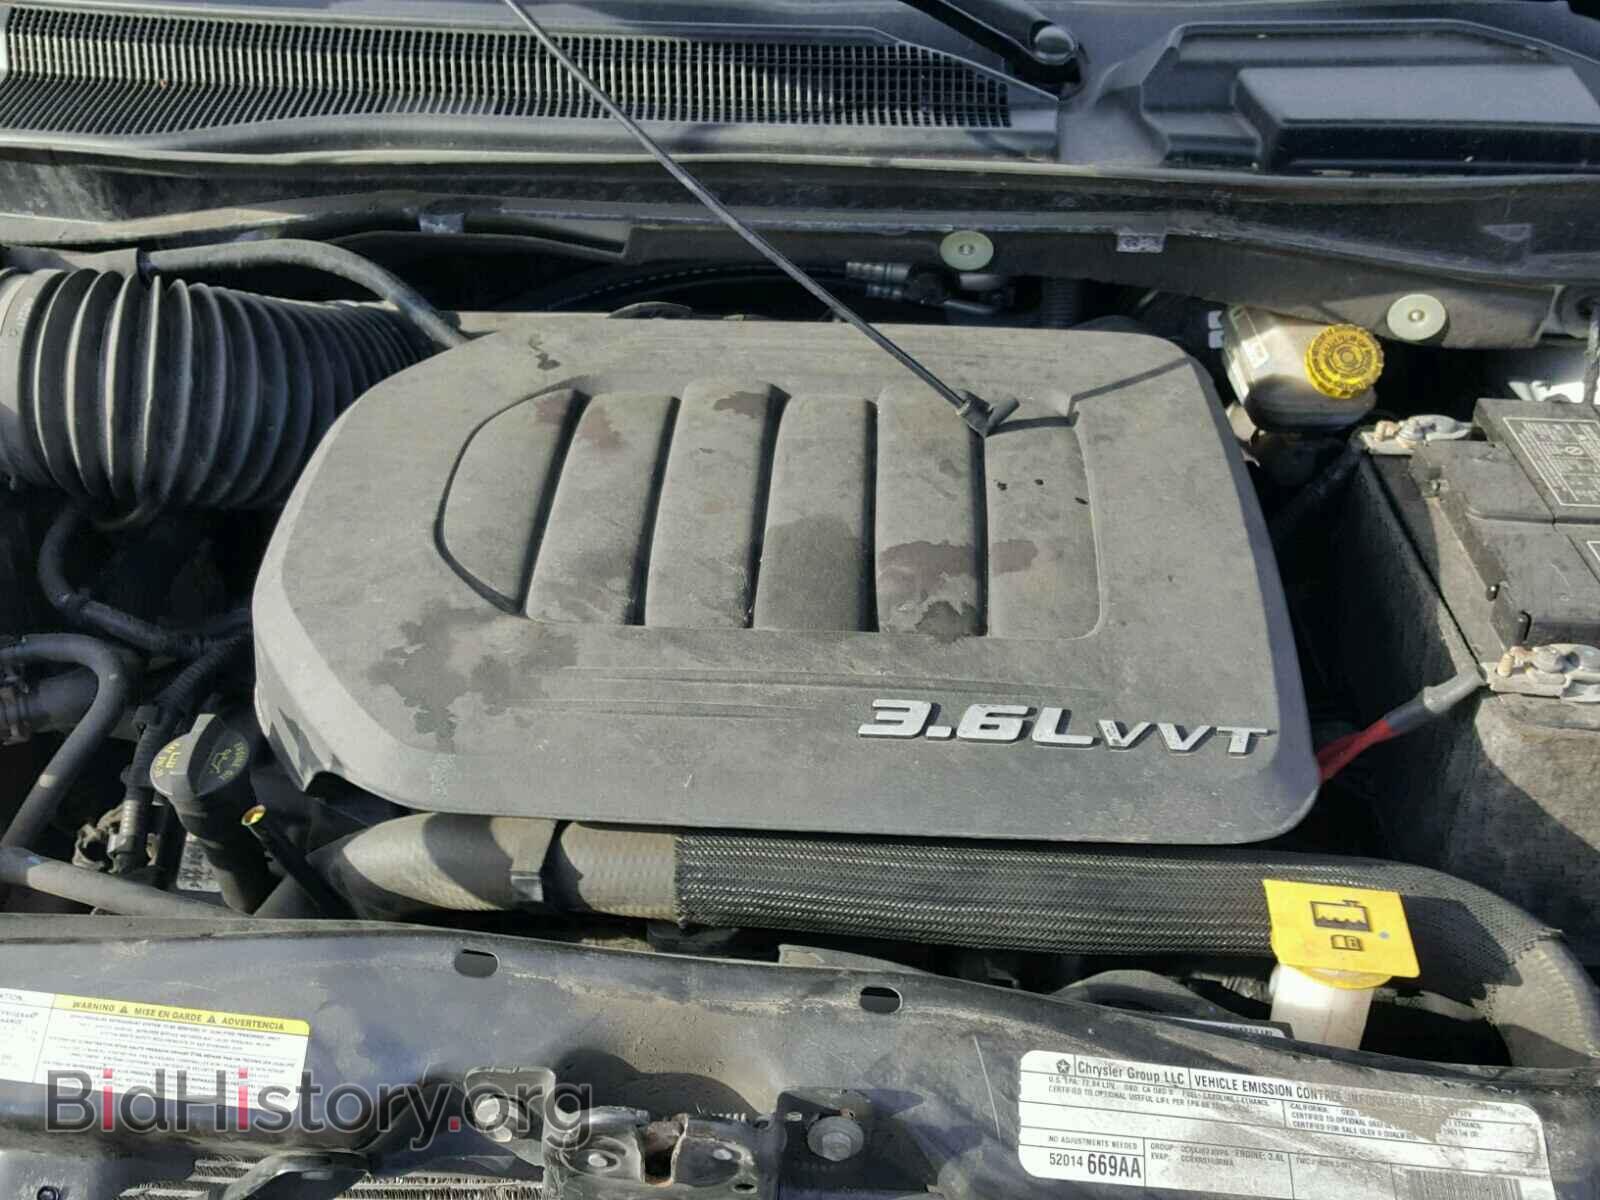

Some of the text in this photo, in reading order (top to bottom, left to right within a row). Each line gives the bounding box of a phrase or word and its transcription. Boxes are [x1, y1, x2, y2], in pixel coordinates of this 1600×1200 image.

[858, 698, 1269, 755] 3.6L VVT
[72, 1001, 285, 1031] WARNING MISE EN GARDE ADVERTENCIA
[1078, 1060, 1123, 1078] Chrysler
[1127, 1066, 1160, 1084] Group
[1165, 1071, 1185, 1085] LLC
[1194, 1074, 1238, 1091] VEHICLE
[1242, 1079, 1293, 1097] EMISSION
[1049, 1152, 1142, 1179] 52014 669AA
